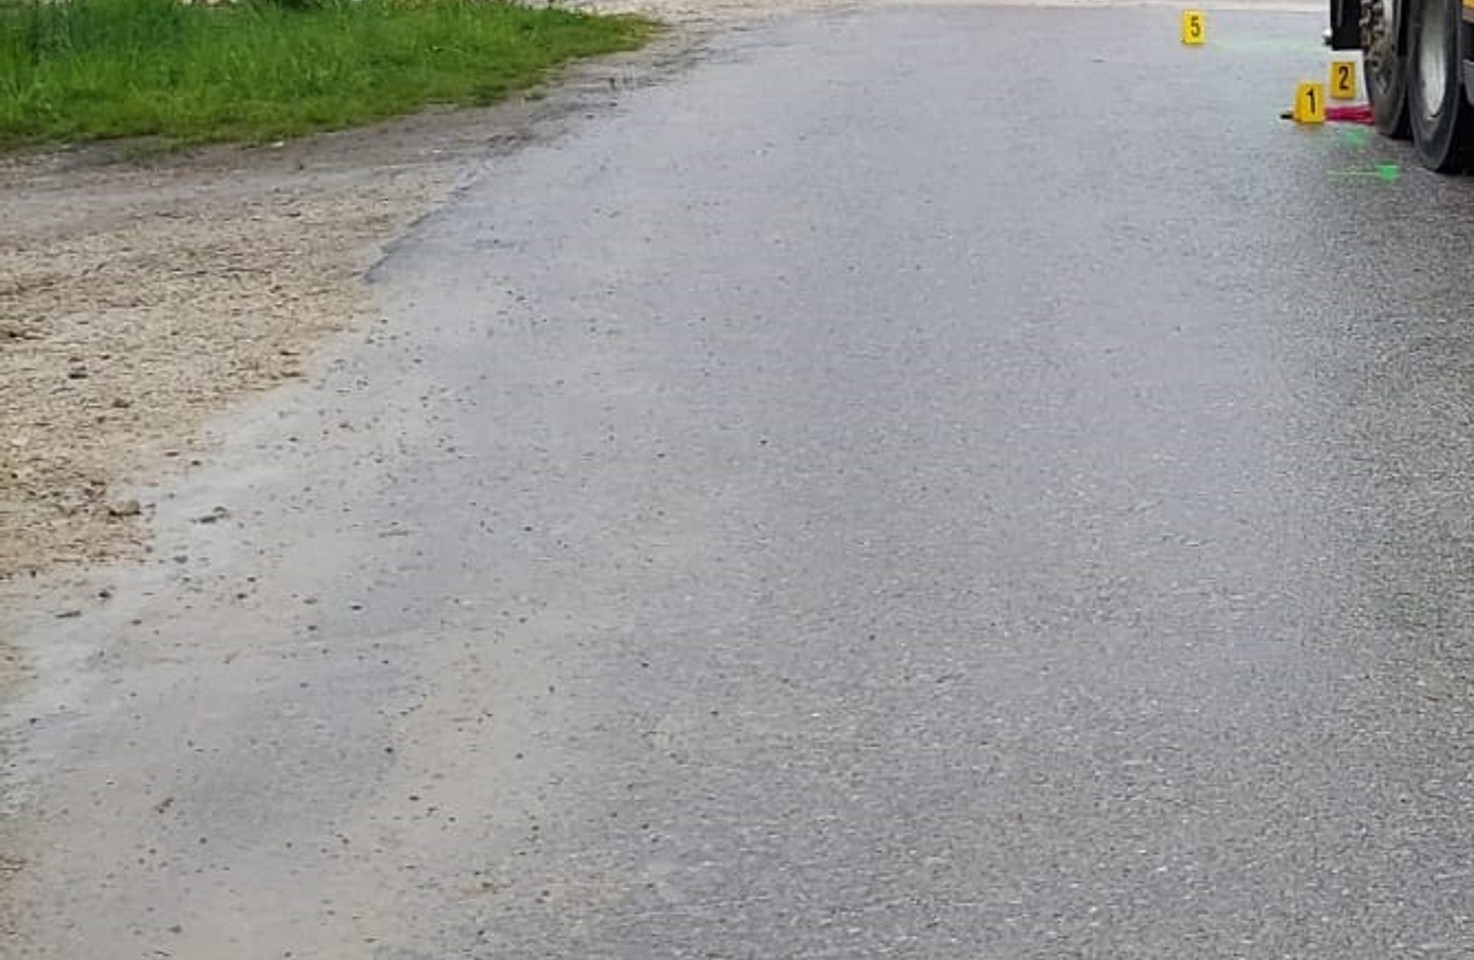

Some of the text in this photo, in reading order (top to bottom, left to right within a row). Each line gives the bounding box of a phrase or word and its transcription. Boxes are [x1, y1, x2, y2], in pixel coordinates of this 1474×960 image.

[1190, 15, 1201, 38] 5
[1338, 65, 1350, 90] 2
[1306, 88, 1317, 115] 1
